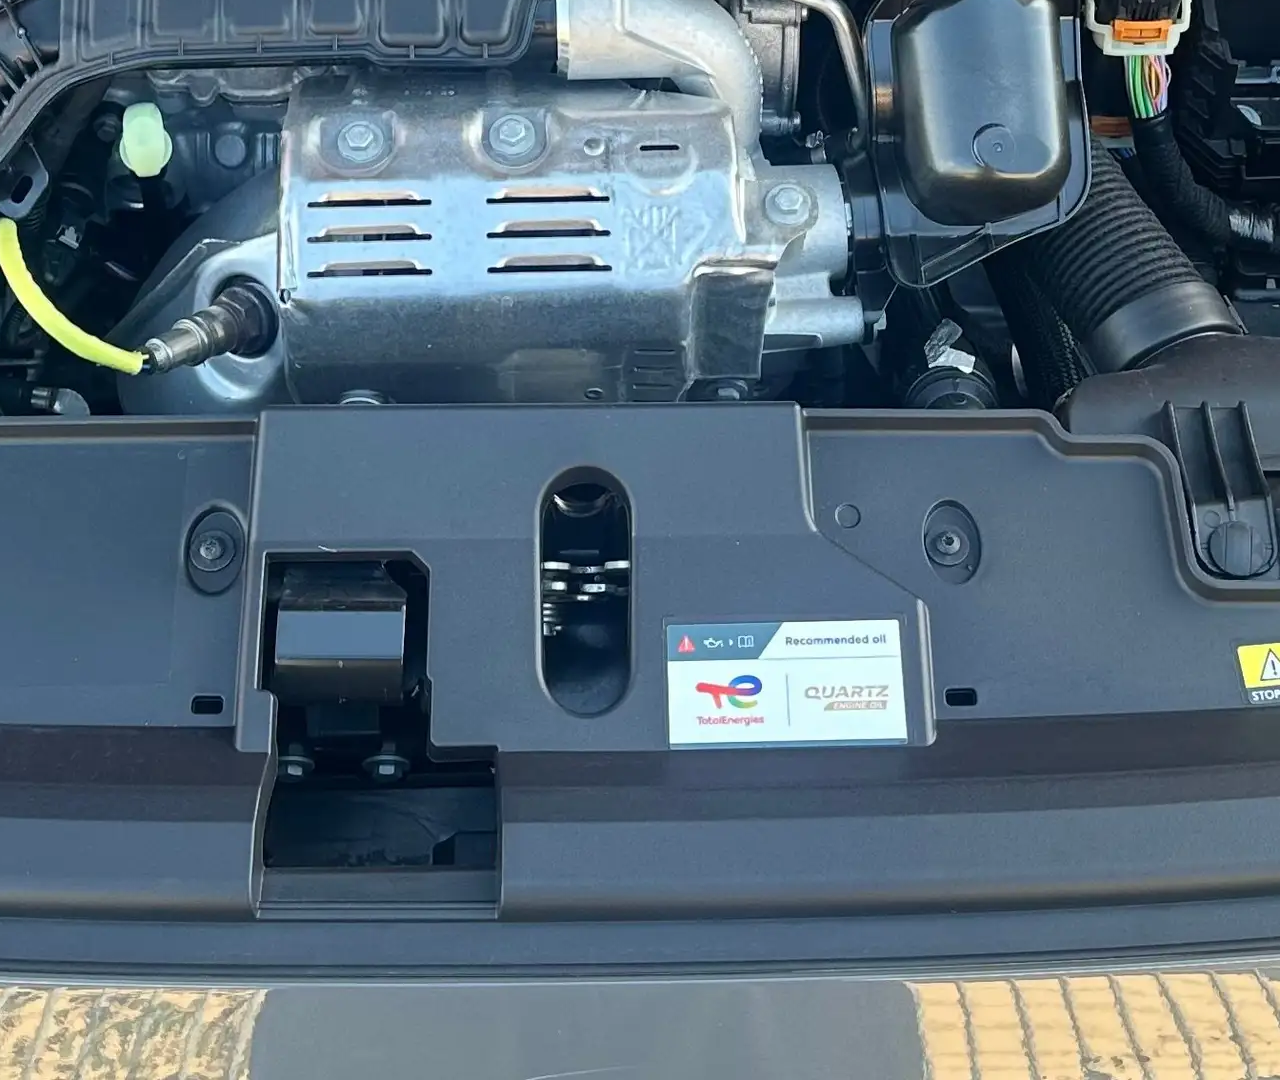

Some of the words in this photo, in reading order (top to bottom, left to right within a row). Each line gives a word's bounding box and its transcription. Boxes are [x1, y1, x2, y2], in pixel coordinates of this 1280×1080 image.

[785, 635, 869, 646] Recommended
[872, 634, 887, 645] oil
[804, 685, 889, 700] QUARTZ
[833, 701, 868, 710] ENGINE
[869, 700, 885, 709] OIL
[696, 715, 765, 727] TotalEnergies
